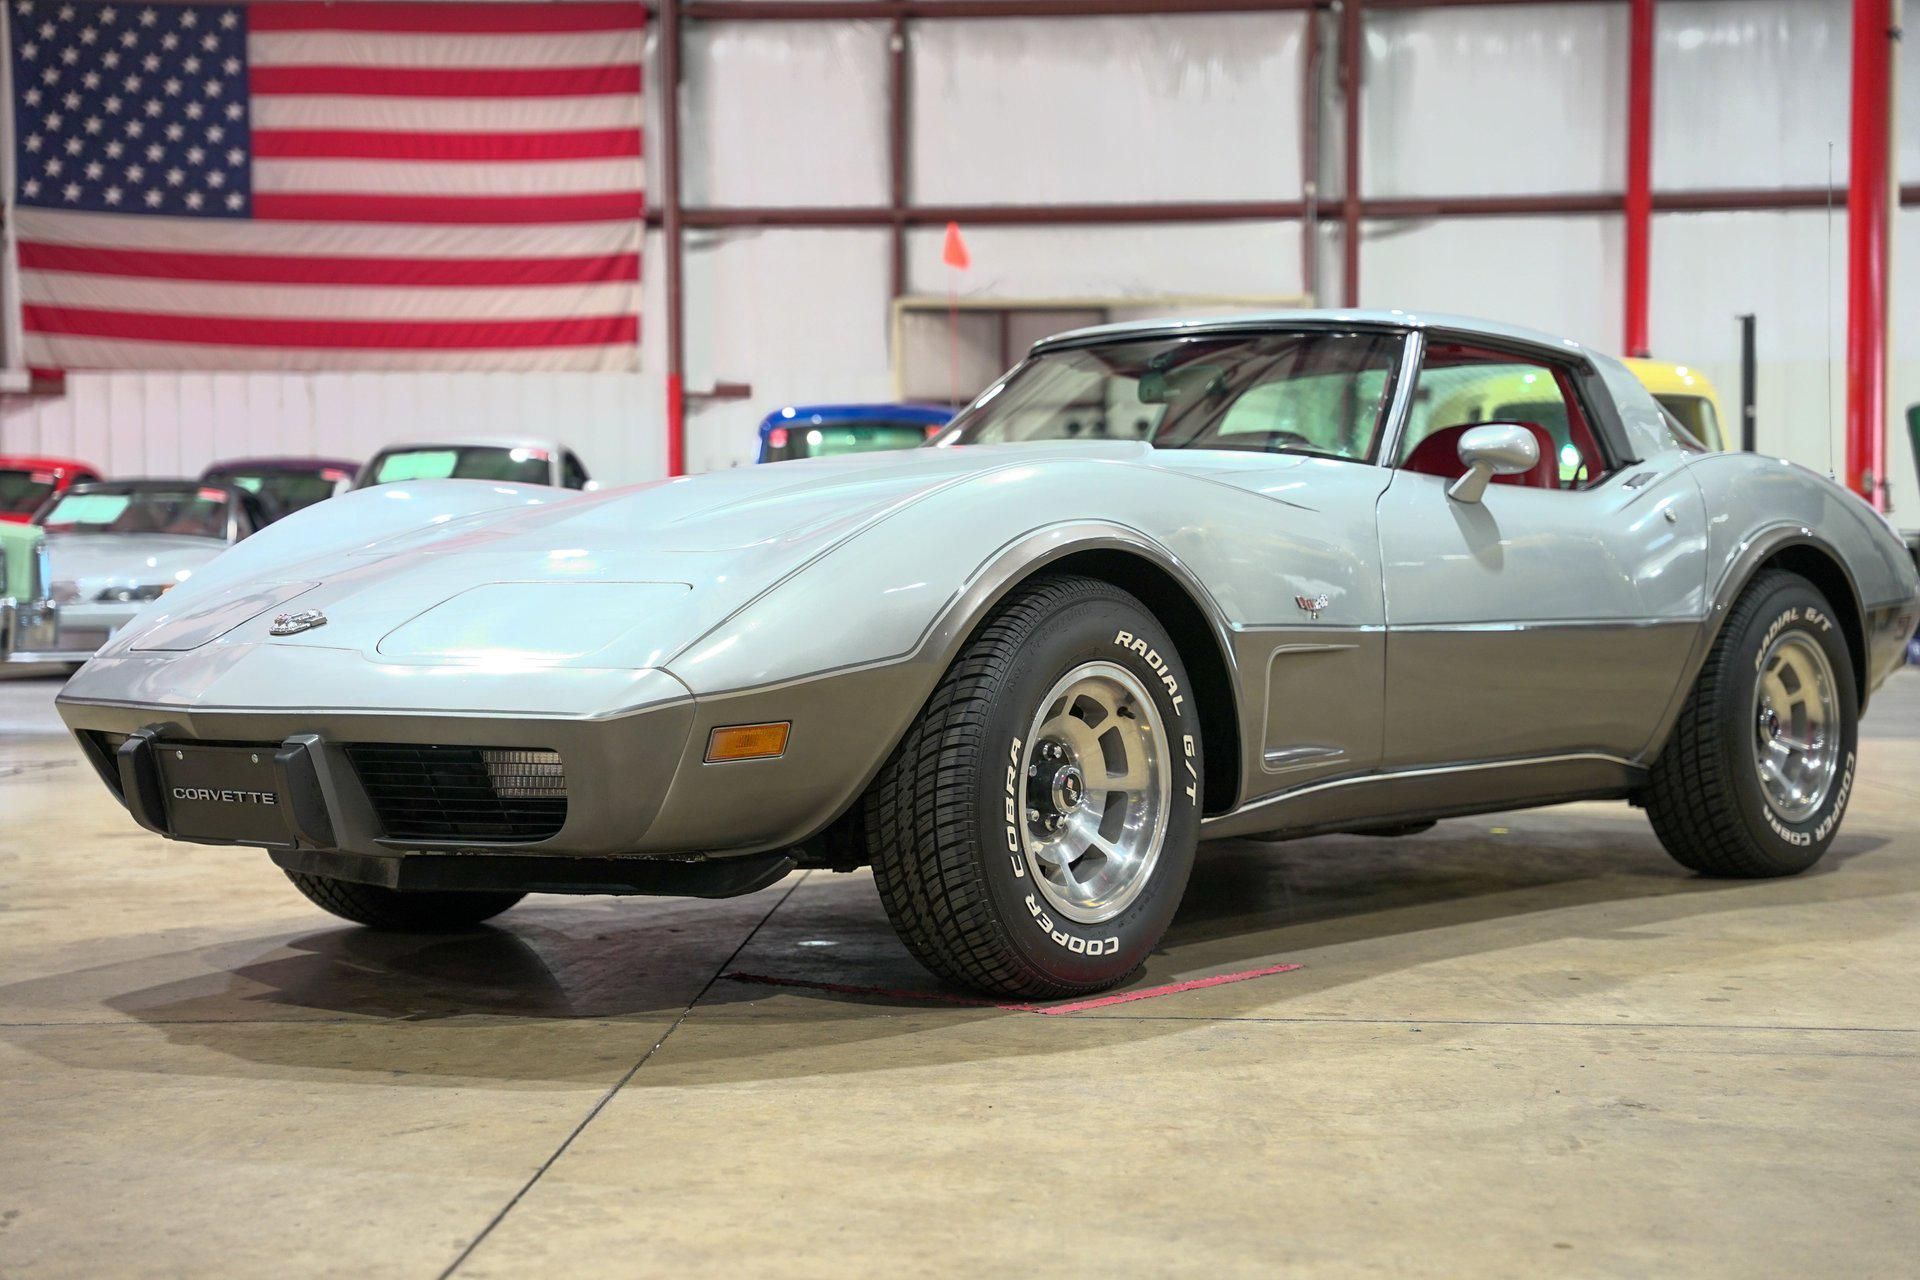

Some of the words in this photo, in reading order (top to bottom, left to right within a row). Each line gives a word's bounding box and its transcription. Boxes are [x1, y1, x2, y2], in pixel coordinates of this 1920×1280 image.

[1755, 606, 1800, 673] RADIAL
[1114, 630, 1186, 717] RADIAL
[1183, 734, 1198, 806] G/T
[173, 787, 275, 805] CORVETTE
[1004, 736, 1025, 879] COBRA
[1763, 804, 1811, 847] COBRA
[1816, 751, 1856, 842] COOPER
[1025, 893, 1120, 957] COOPER
